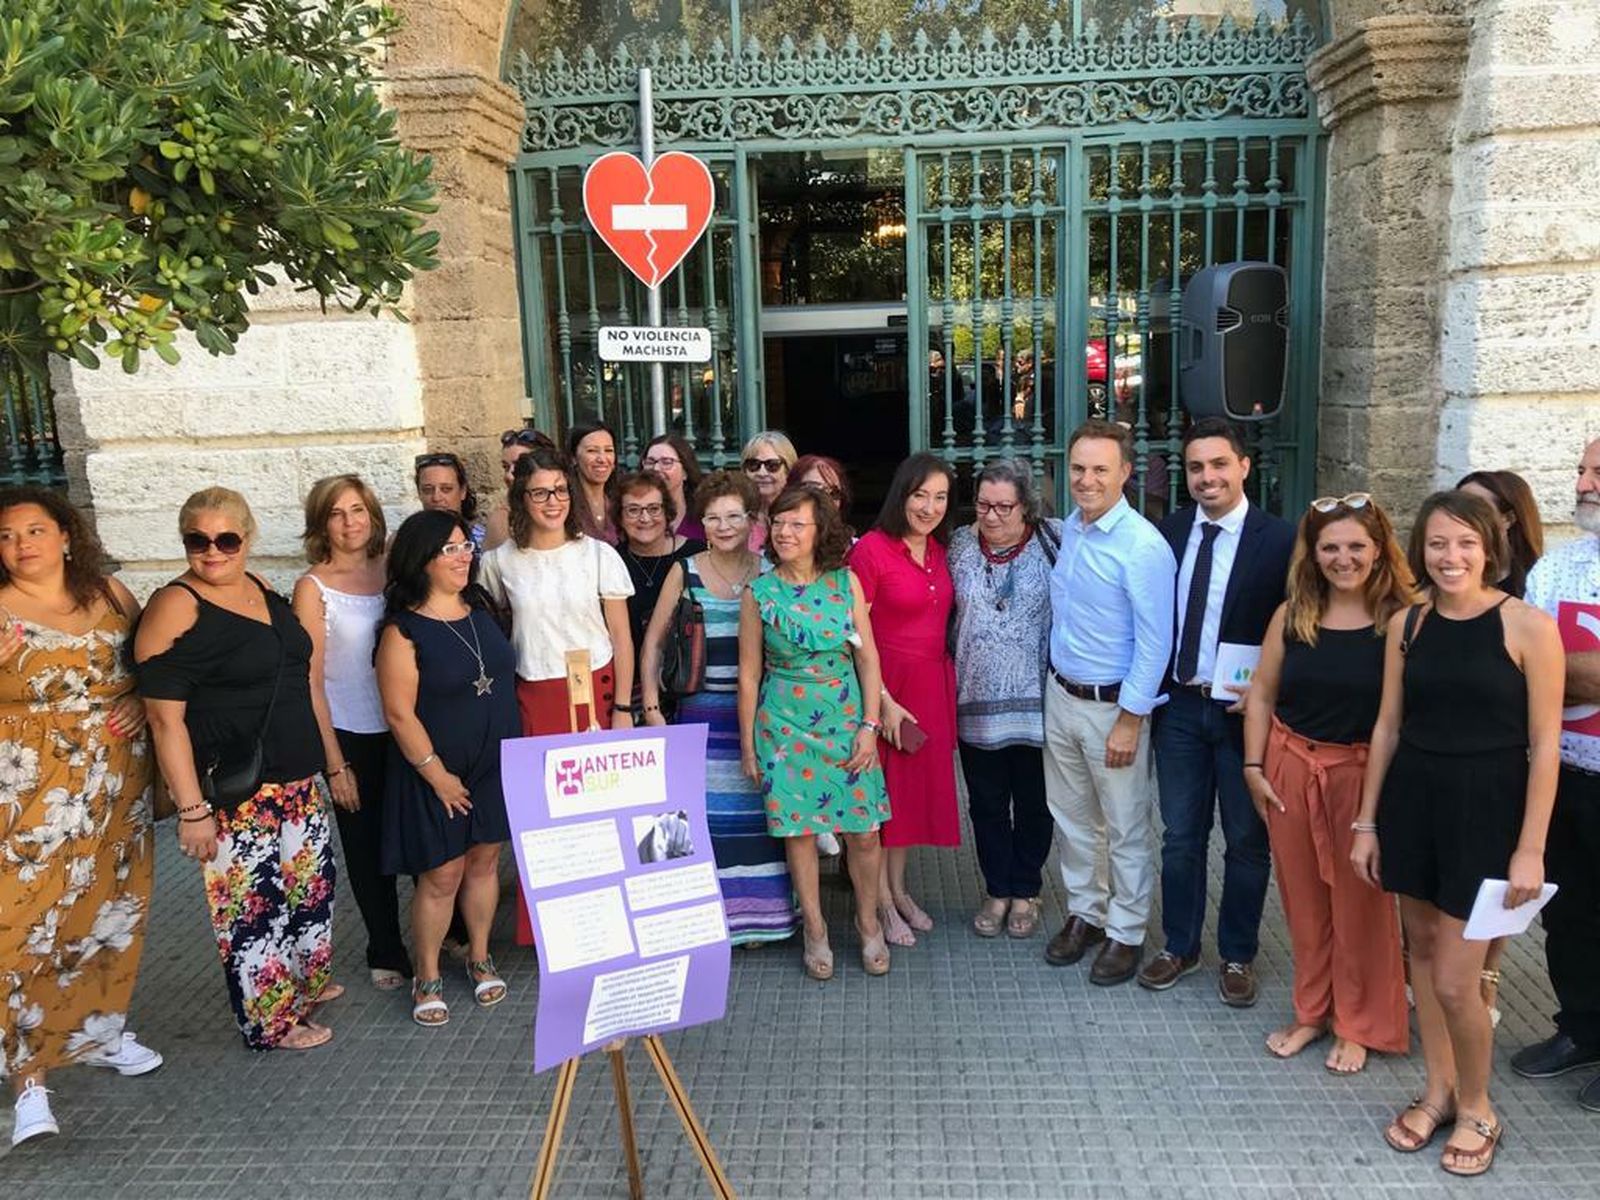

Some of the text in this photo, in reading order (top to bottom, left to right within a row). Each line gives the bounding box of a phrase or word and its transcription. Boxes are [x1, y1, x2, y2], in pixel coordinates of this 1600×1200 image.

[608, 330, 701, 341] NO VIOLENCIA
[622, 345, 687, 356] MACHISTA
[584, 750, 657, 773] ANTENA
[585, 772, 620, 792] SUR
